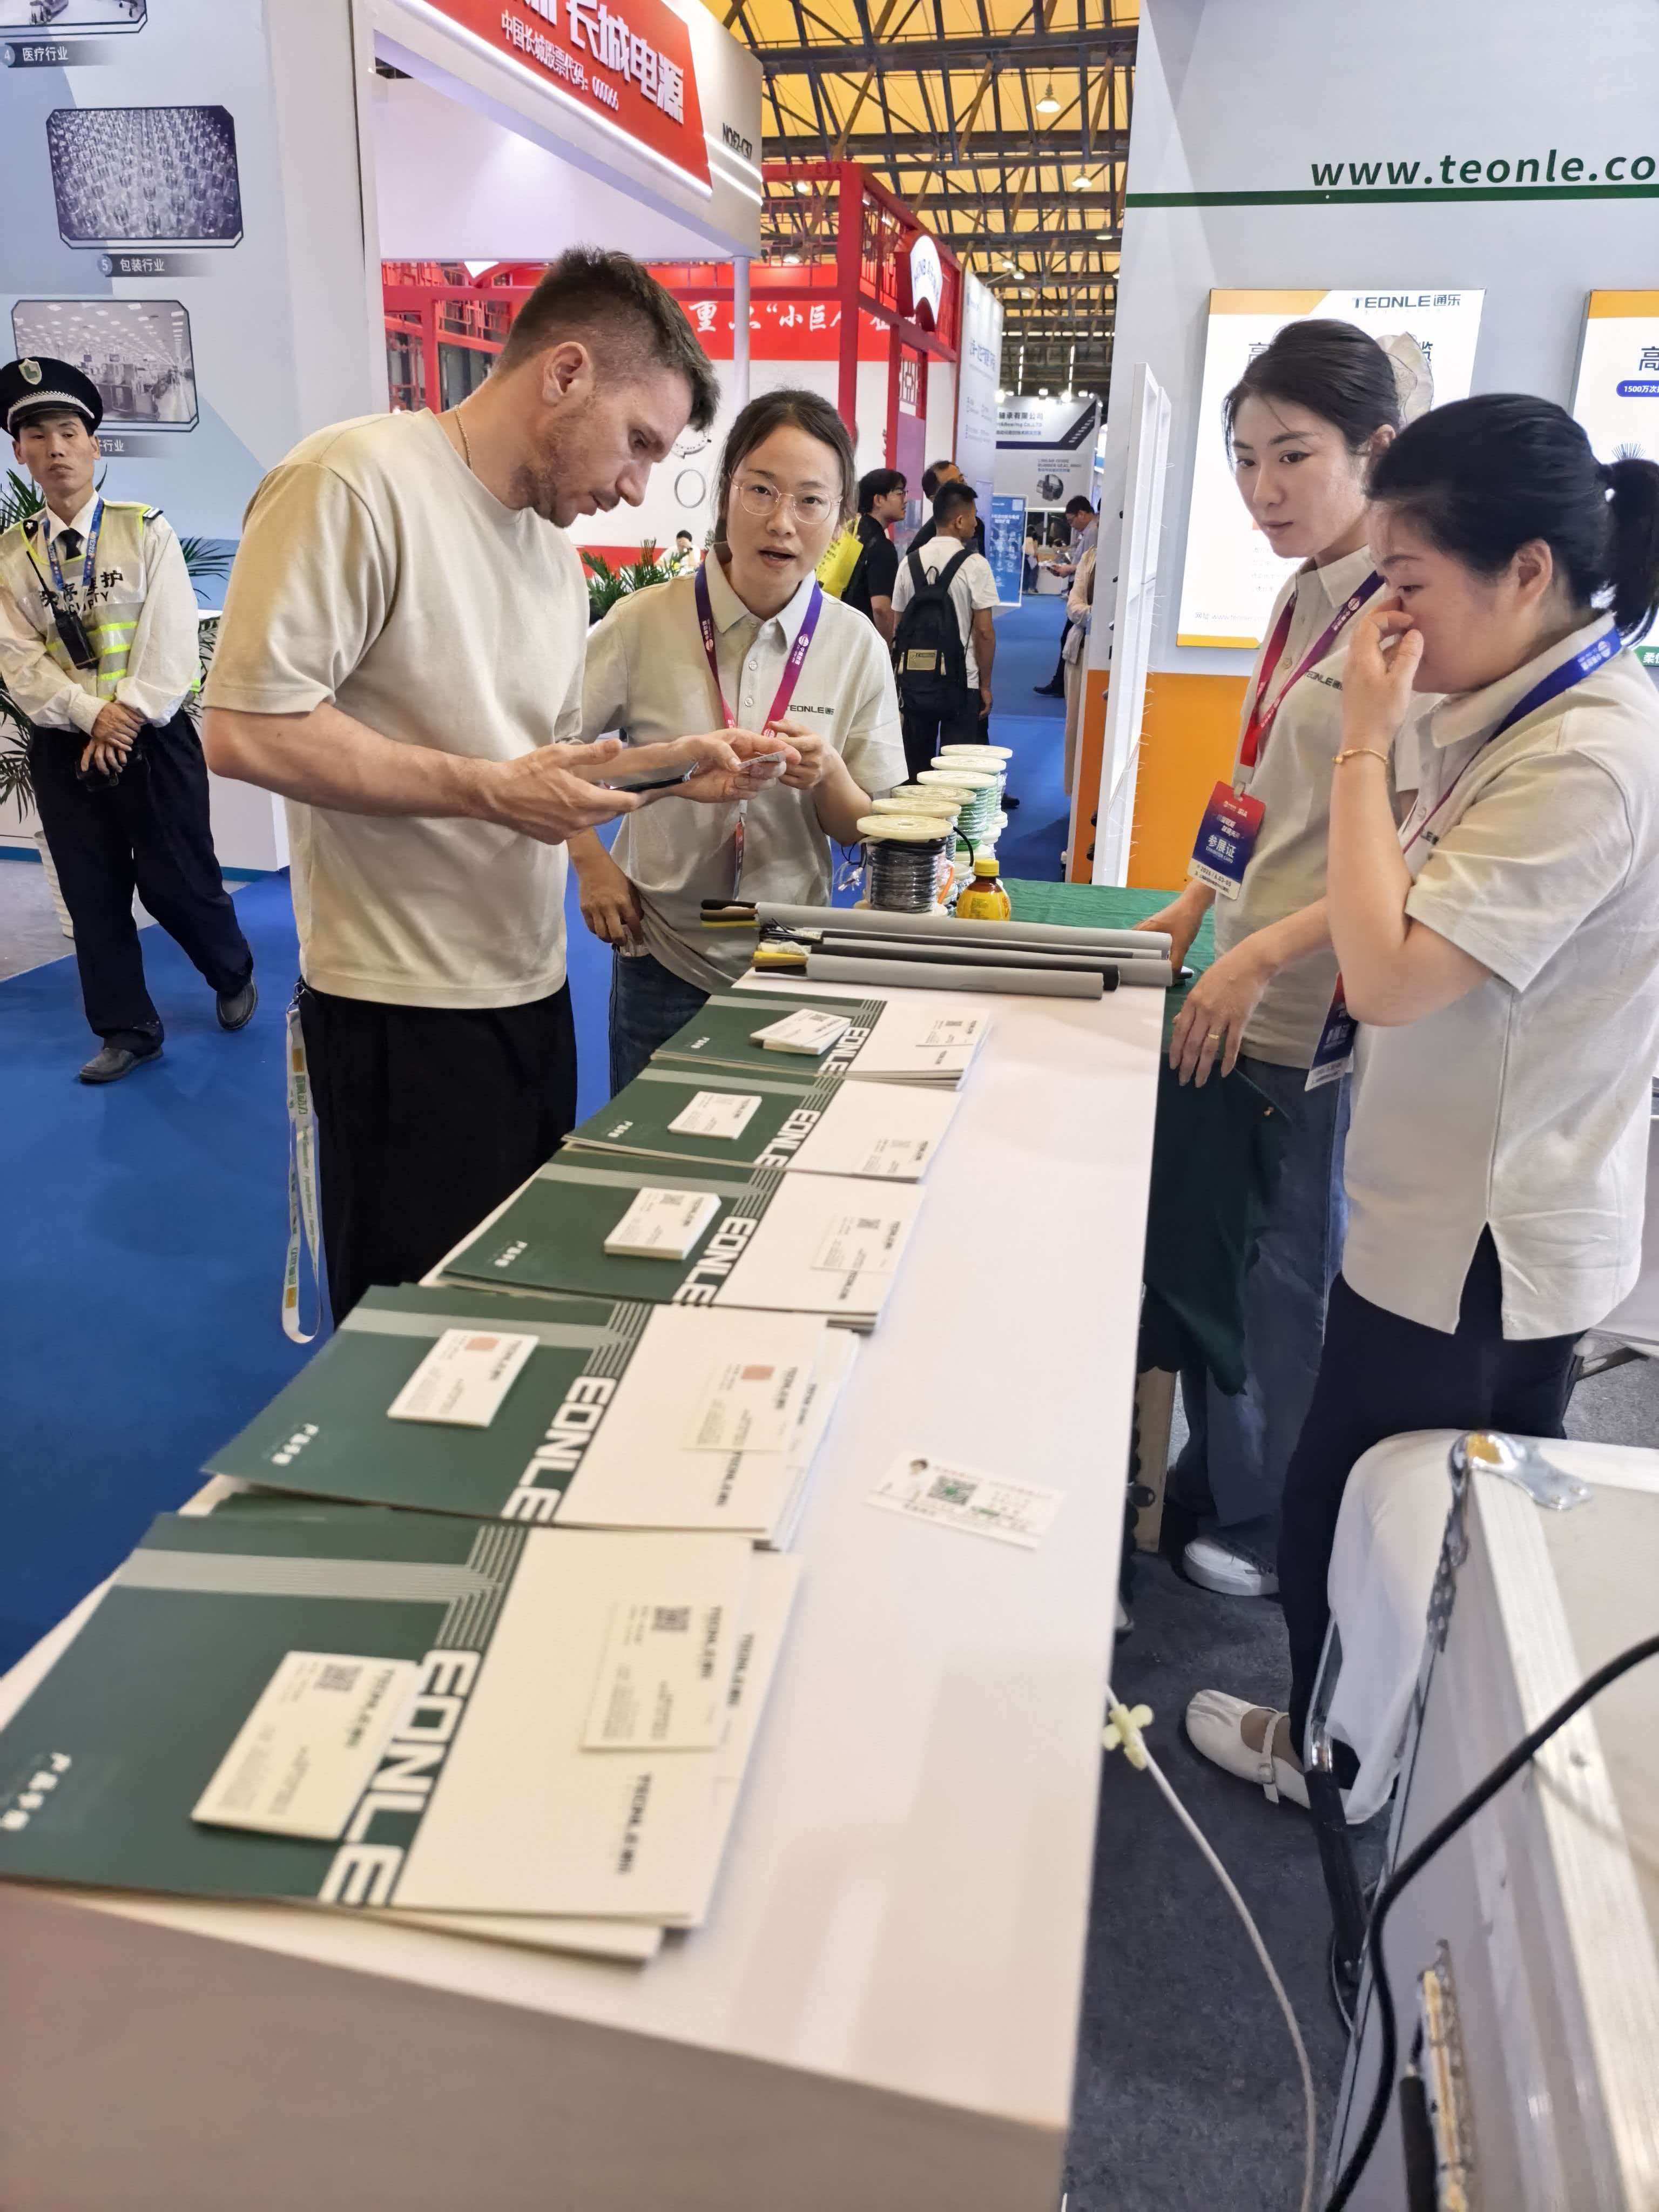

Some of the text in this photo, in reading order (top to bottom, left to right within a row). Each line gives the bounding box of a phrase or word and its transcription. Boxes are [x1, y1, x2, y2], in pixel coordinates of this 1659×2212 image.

[22, 46, 69, 62] 医疗行业
[1311, 149, 1656, 186] www.teonle.co
[101, 258, 165, 272] 5 包装行业
[1208, 834, 1237, 859] 参展证
